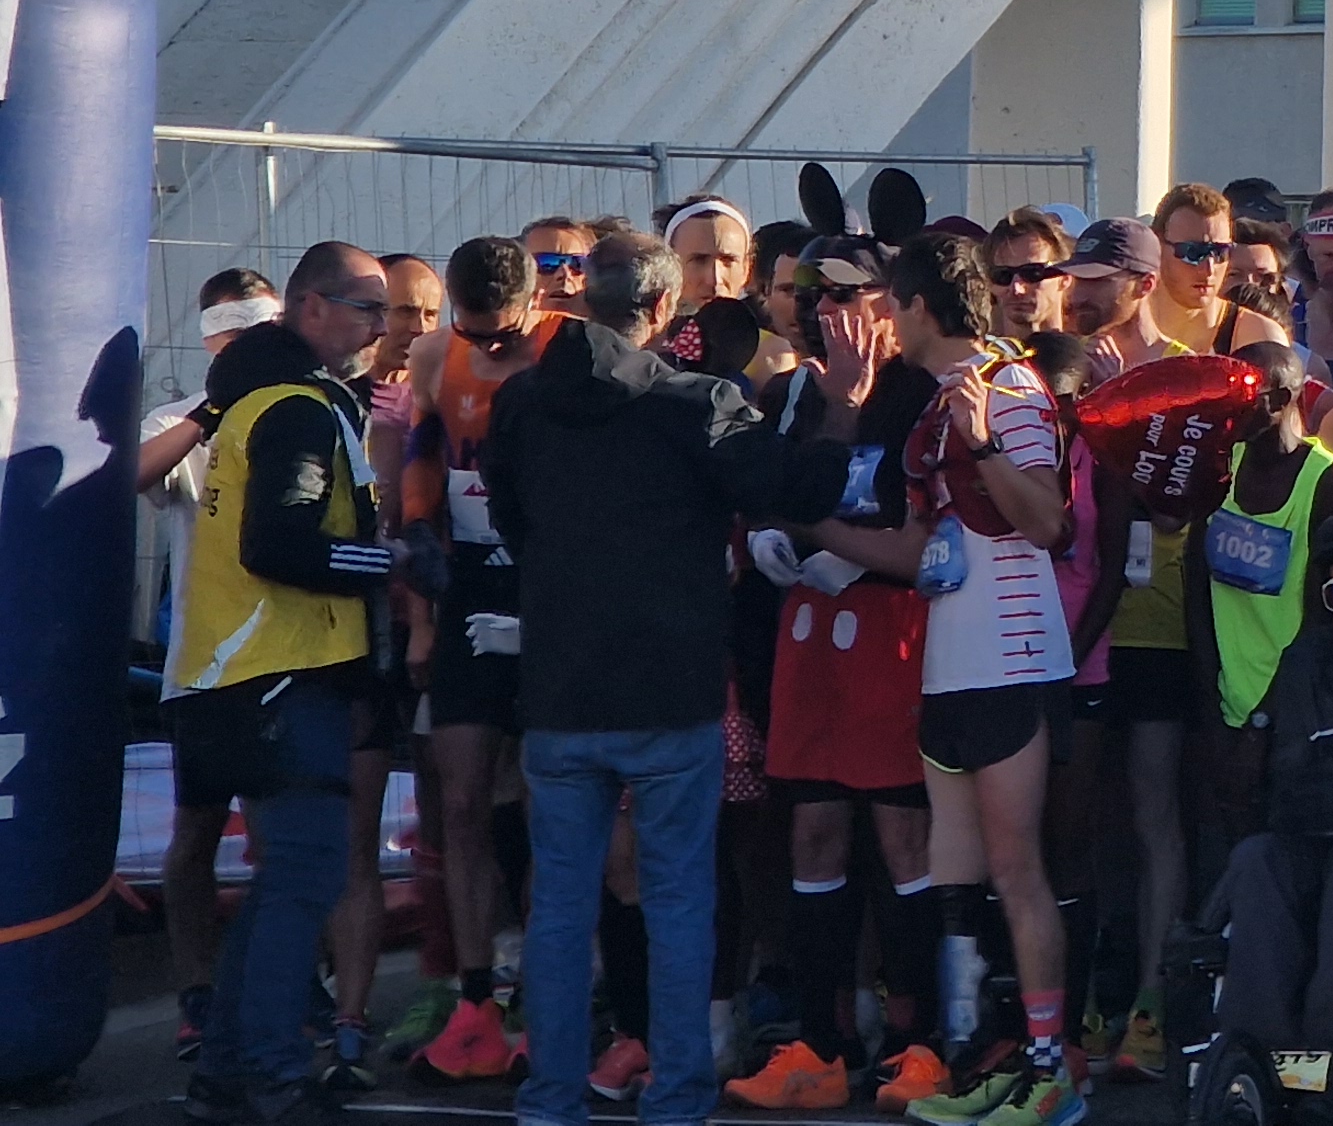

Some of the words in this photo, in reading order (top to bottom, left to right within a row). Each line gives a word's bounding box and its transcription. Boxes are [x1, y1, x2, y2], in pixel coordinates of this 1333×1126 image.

[1146, 413, 1166, 447] pour
[1186, 414, 1214, 440] Je
[1164, 444, 1198, 496] cours
[1215, 530, 1274, 568] 1002
